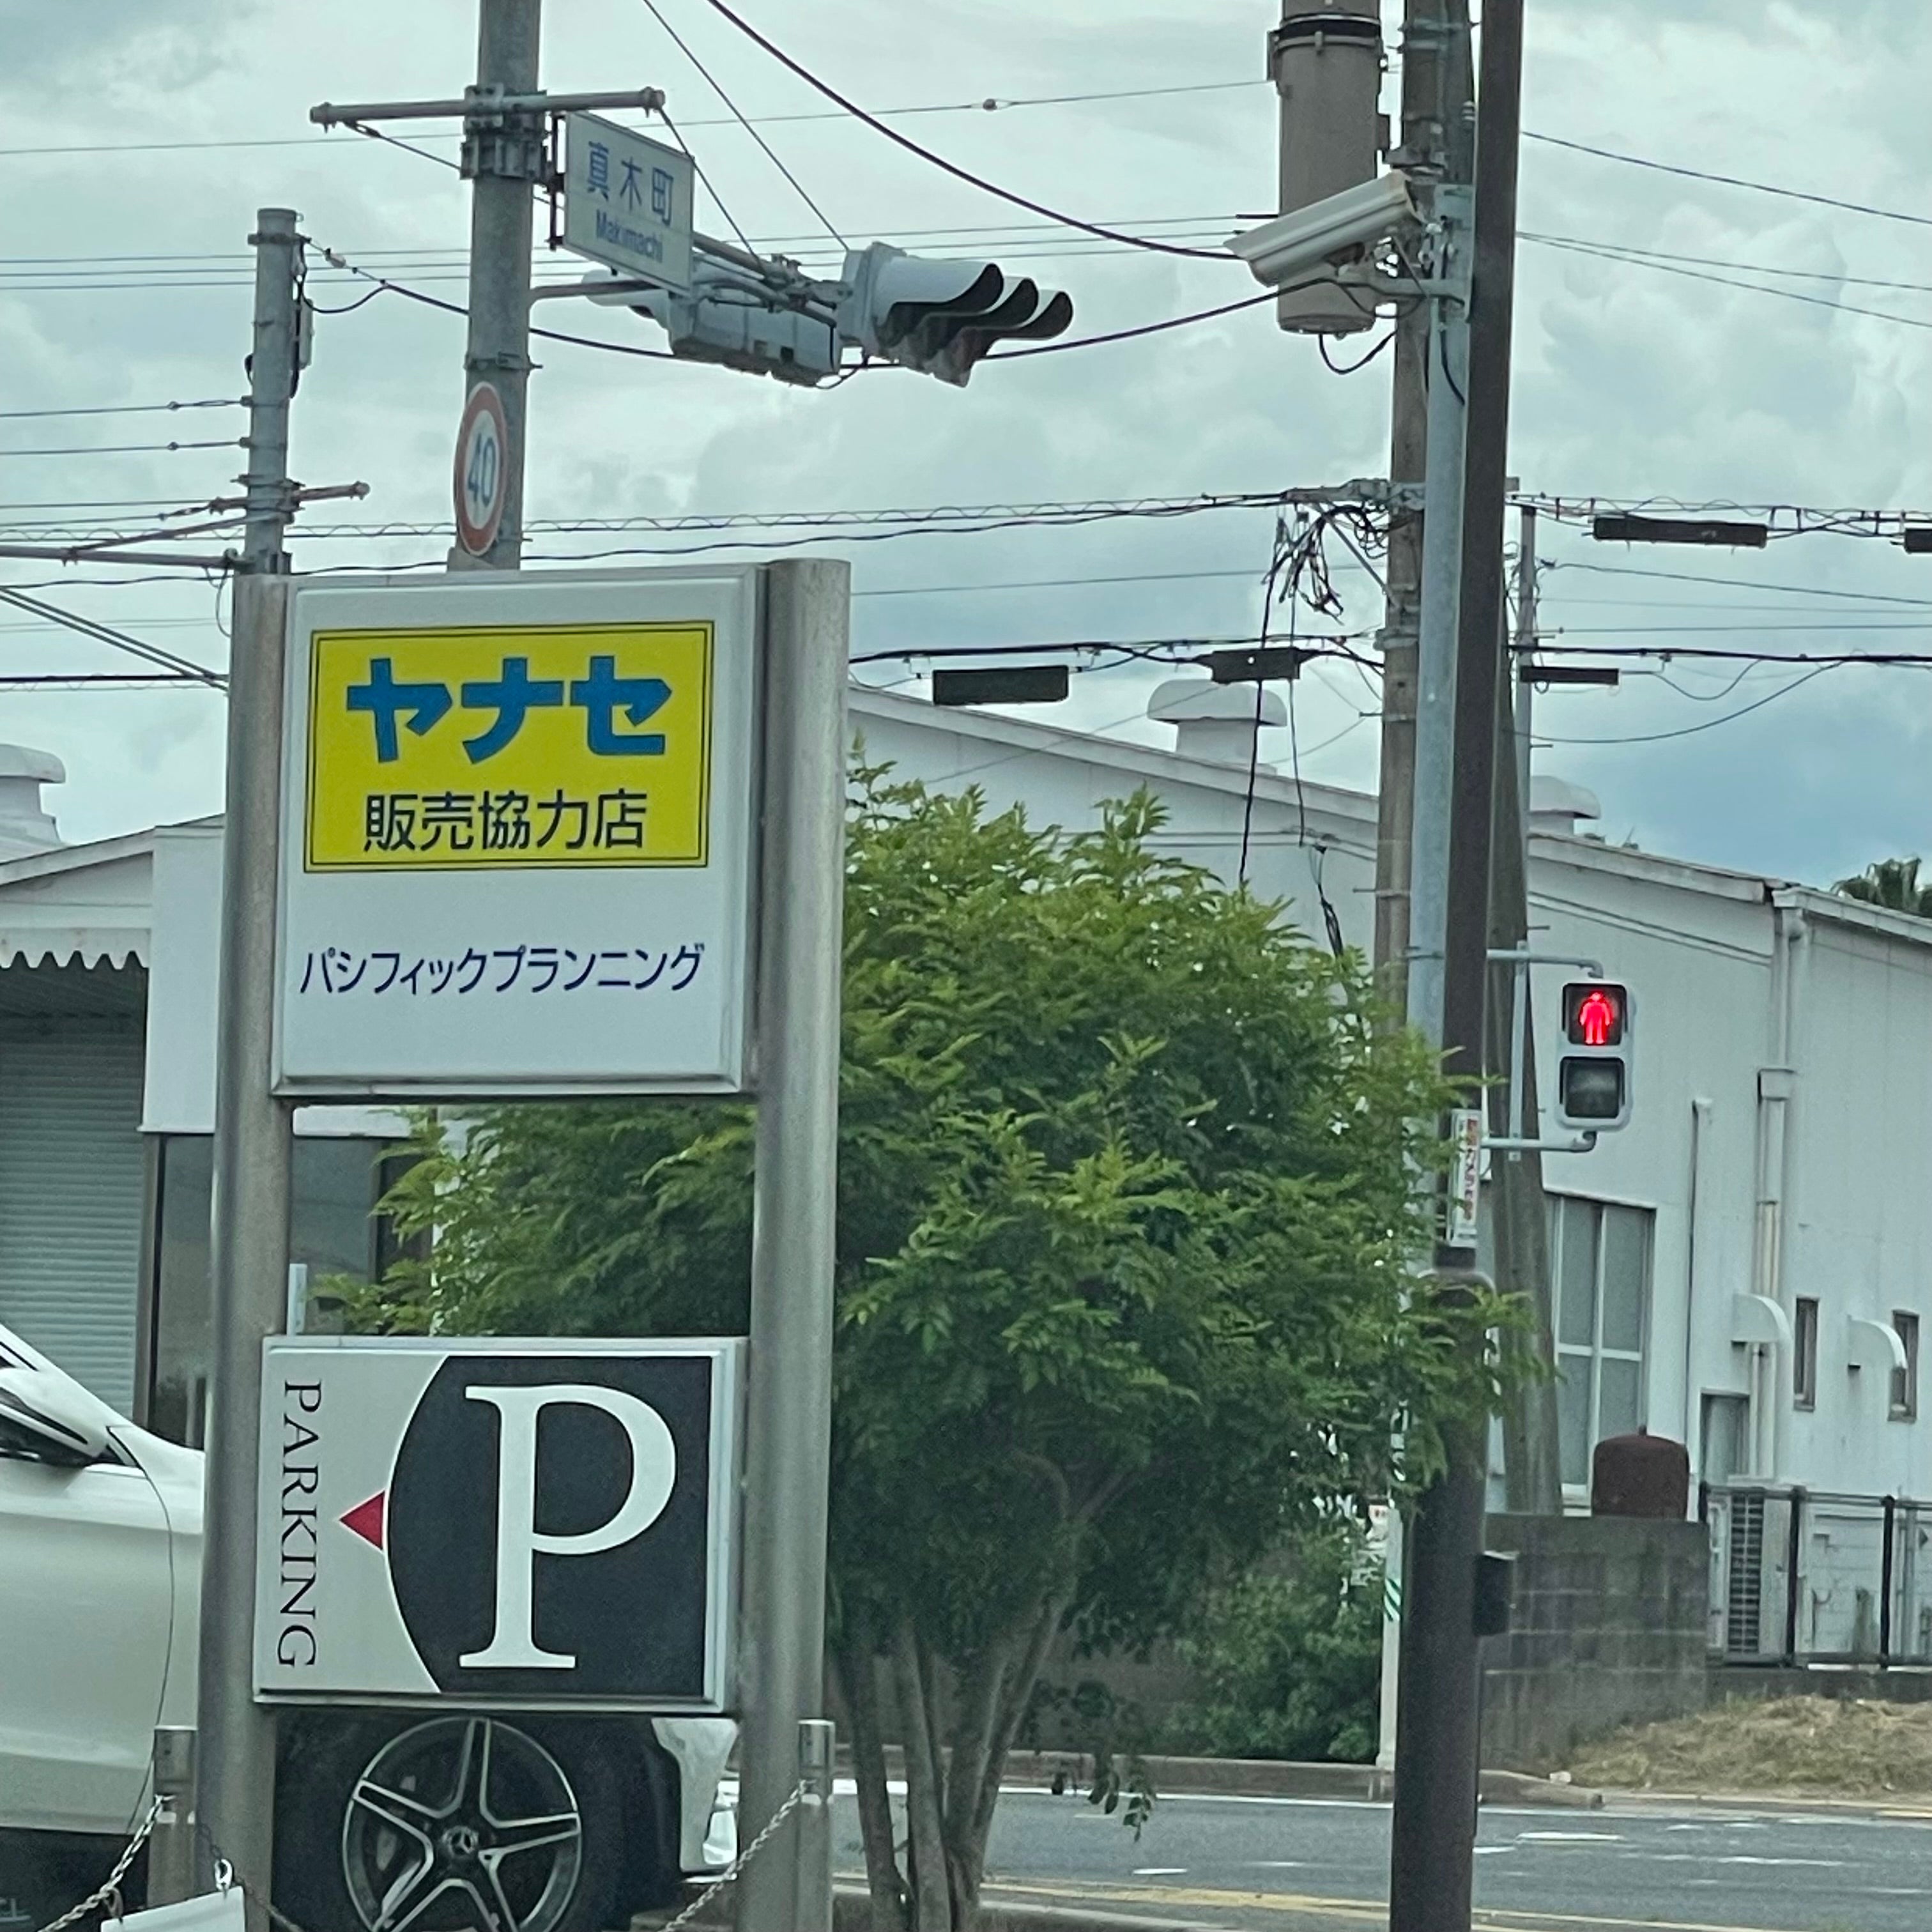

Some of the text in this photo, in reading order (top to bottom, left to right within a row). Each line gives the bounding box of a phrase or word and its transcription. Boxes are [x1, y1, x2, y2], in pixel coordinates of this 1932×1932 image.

[587, 141, 673, 227] 真木町
[468, 433, 496, 508] 40
[347, 656, 672, 765] ヤナセ
[364, 788, 647, 851] 販売協力店
[300, 944, 705, 995] パシフィックプランニング
[277, 1380, 322, 1668] PARKING
[459, 1384, 676, 1668] P
